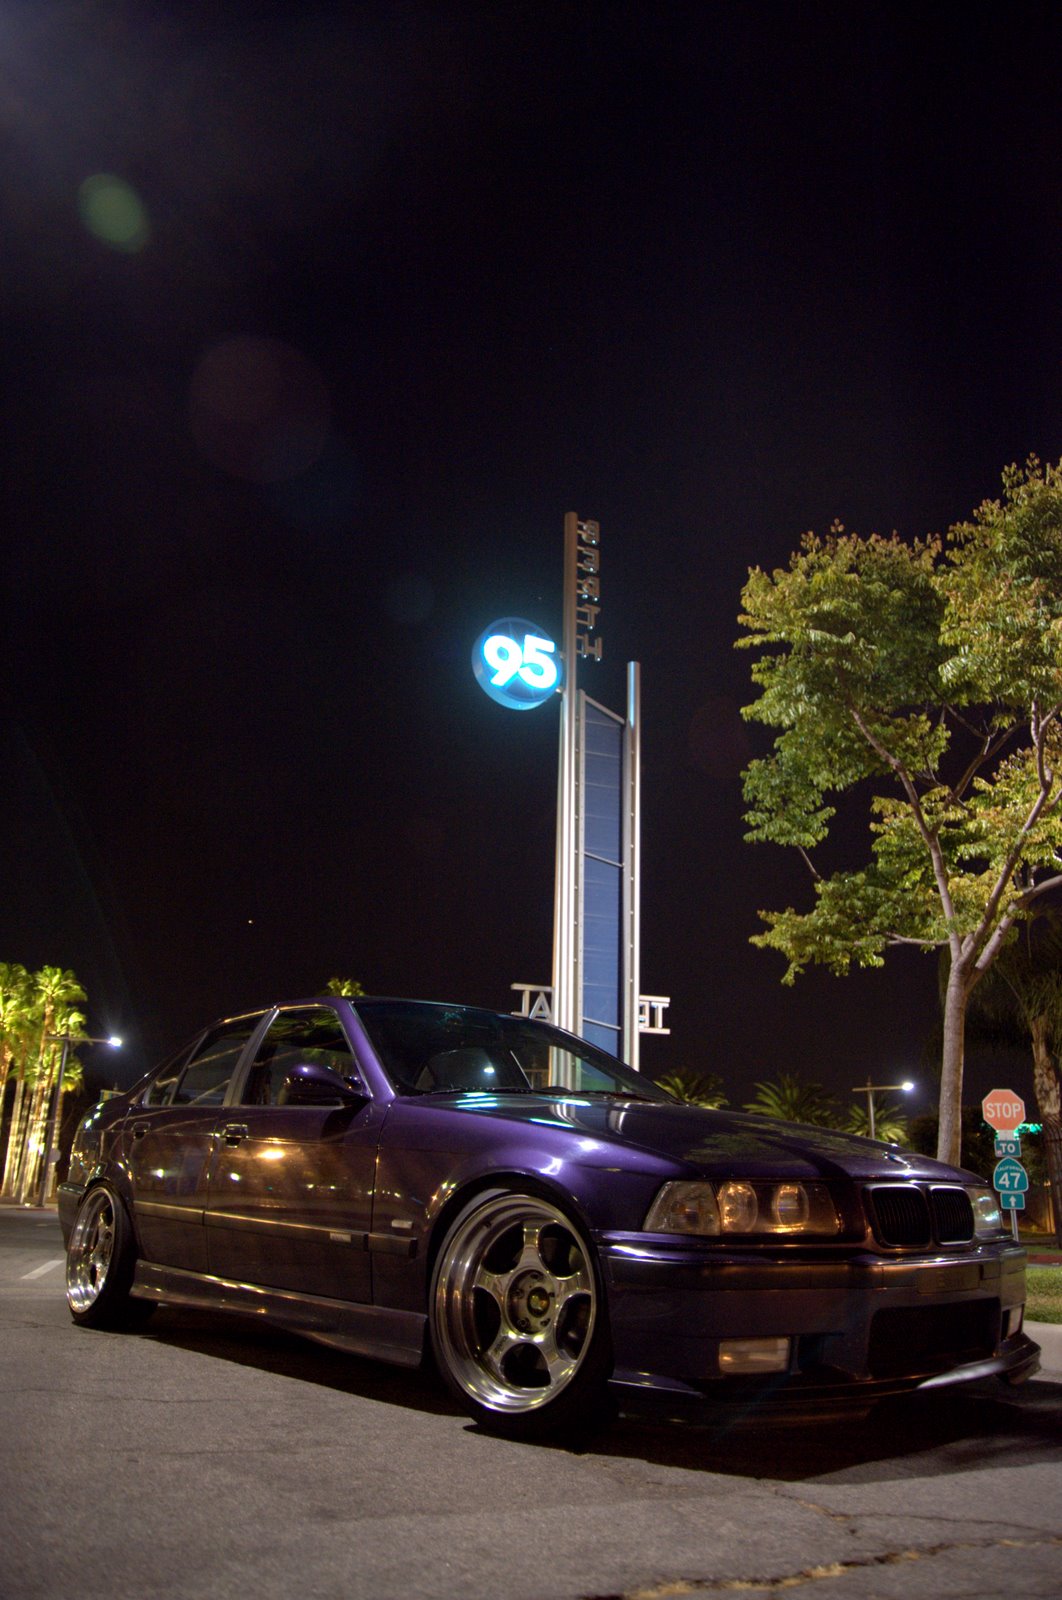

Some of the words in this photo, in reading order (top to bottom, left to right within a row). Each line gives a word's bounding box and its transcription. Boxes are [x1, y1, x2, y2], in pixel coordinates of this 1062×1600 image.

[483, 634, 557, 689] 95
[986, 1103, 1021, 1118] STOP
[1000, 1143, 1015, 1153] TO
[998, 1172, 1021, 1189] 47
